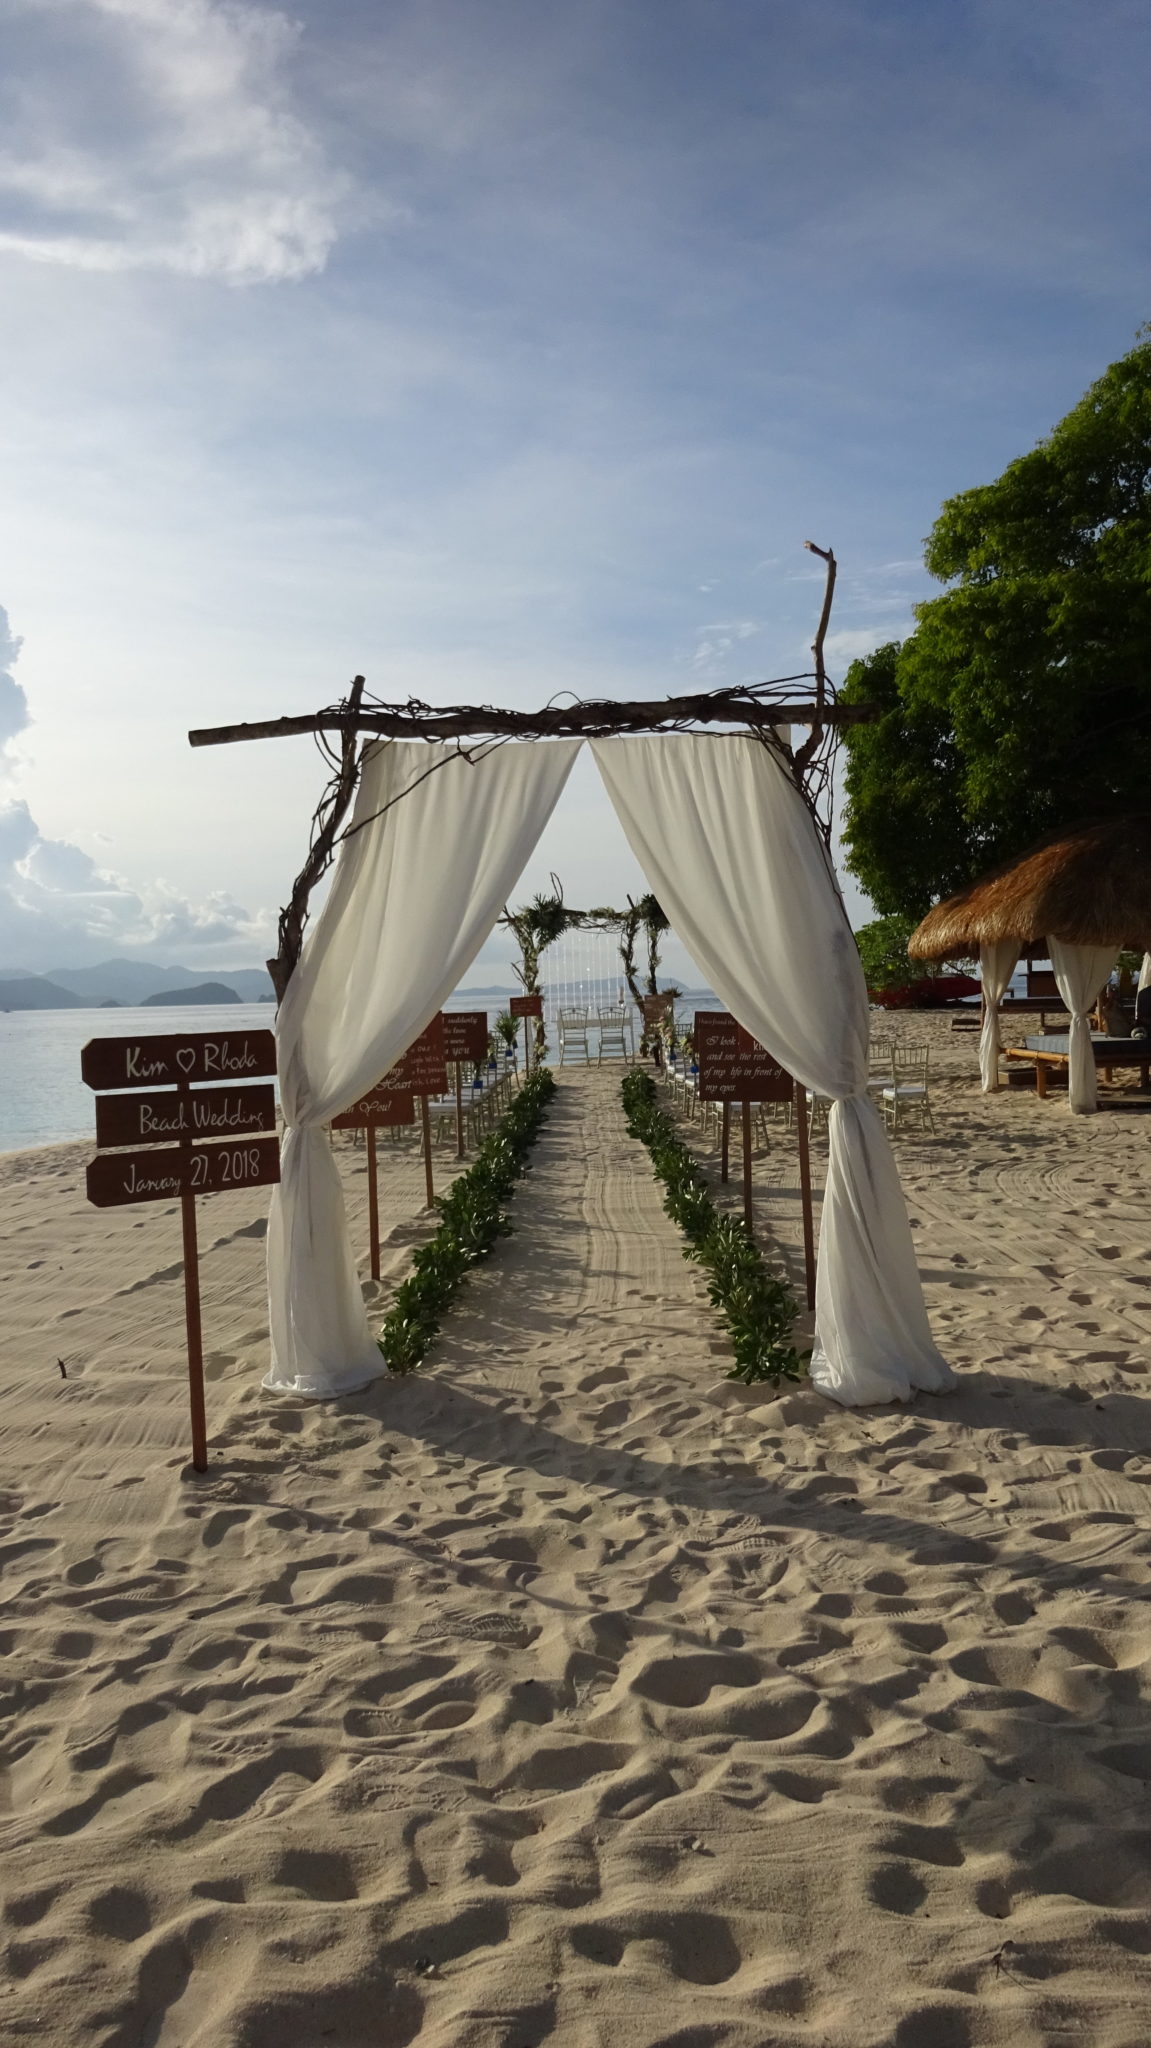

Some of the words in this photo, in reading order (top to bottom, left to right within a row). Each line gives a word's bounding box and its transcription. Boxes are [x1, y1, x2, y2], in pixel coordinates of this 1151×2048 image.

[720, 1035, 737, 1046] look
[126, 1047, 168, 1078] Kim
[204, 1040, 258, 1072] Rhoda
[706, 1051, 723, 1061] and
[740, 1053, 751, 1061] the
[753, 1053, 767, 1061] rest
[703, 1066, 715, 1079] of
[713, 1069, 726, 1079] my
[730, 1066, 742, 1079] life
[743, 1068, 751, 1076] in
[751, 1066, 773, 1080] front
[773, 1069, 783, 1080] of
[705, 1084, 718, 1094] my
[719, 1084, 736, 1094] eyes
[140, 1102, 190, 1134] Beach
[192, 1098, 264, 1132] Wedding
[123, 1164, 182, 1196] January
[190, 1154, 212, 1185] 27,
[218, 1148, 260, 1181] 2018
